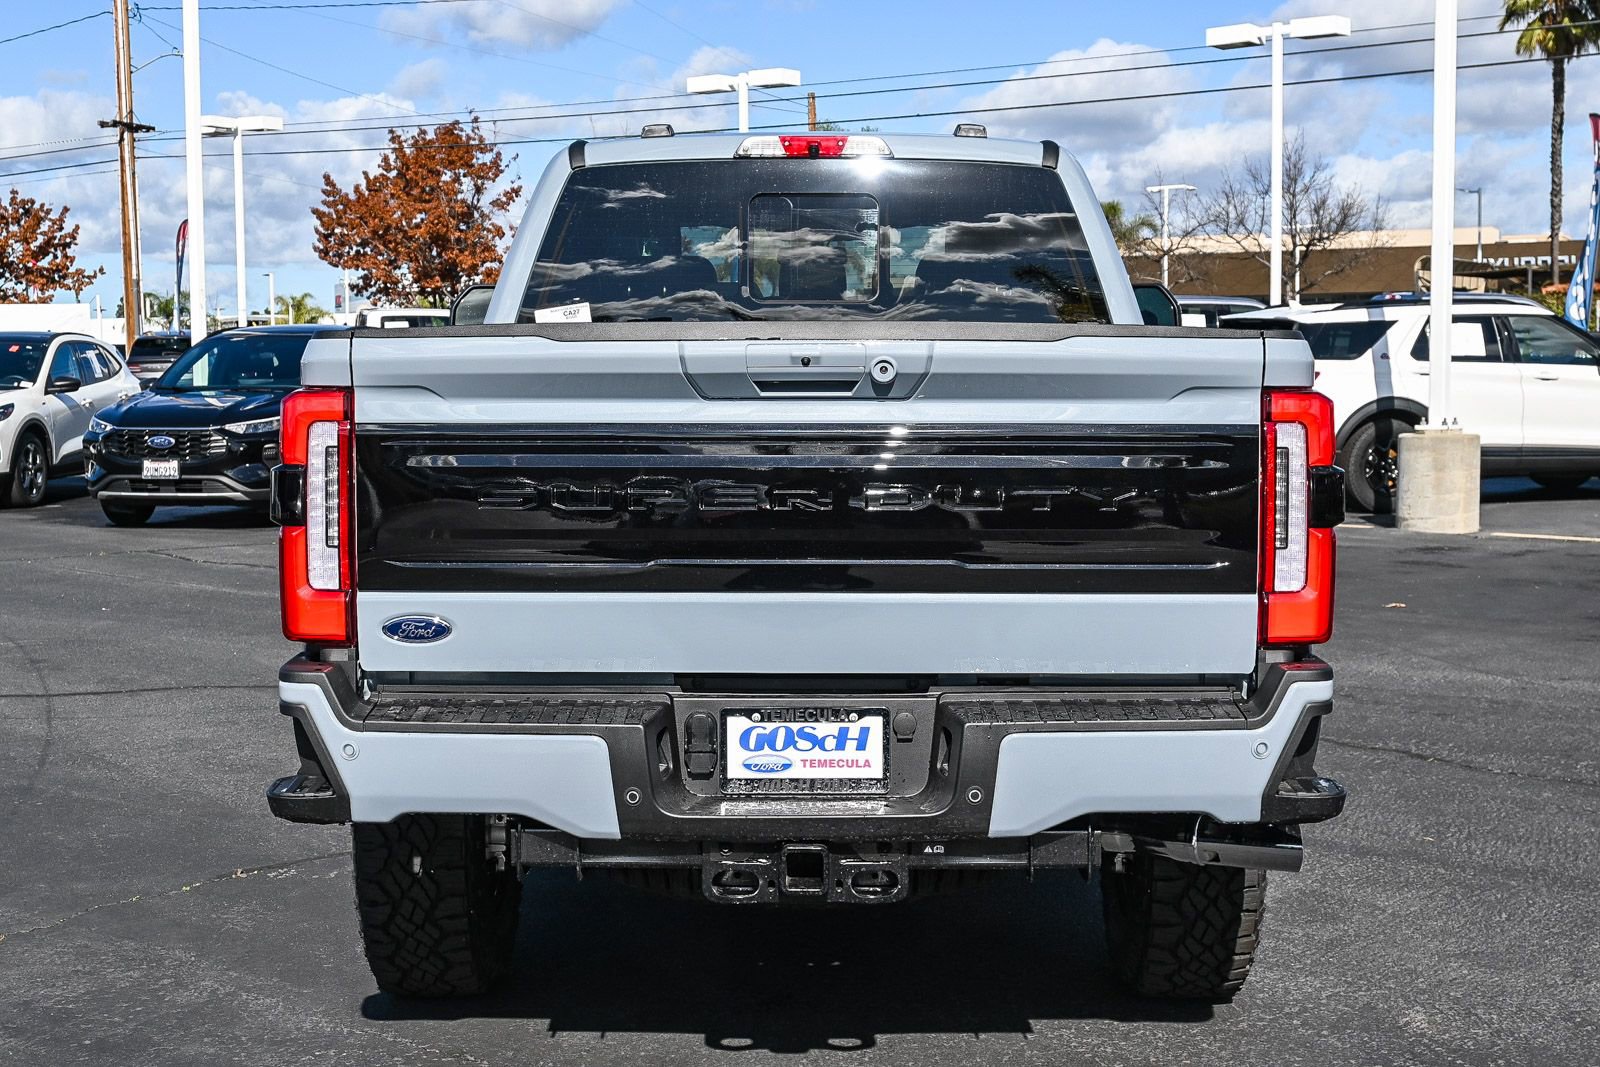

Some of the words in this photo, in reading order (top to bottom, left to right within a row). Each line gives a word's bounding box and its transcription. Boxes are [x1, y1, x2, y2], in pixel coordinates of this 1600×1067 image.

[563, 308, 580, 317] CA27
[478, 485, 833, 511] SUPER
[862, 484, 1139, 511] DUTY
[398, 621, 436, 638] Ford
[761, 708, 849, 721] TEMECULA
[747, 756, 787, 772] Ford
[801, 758, 872, 769] TEMECULA
